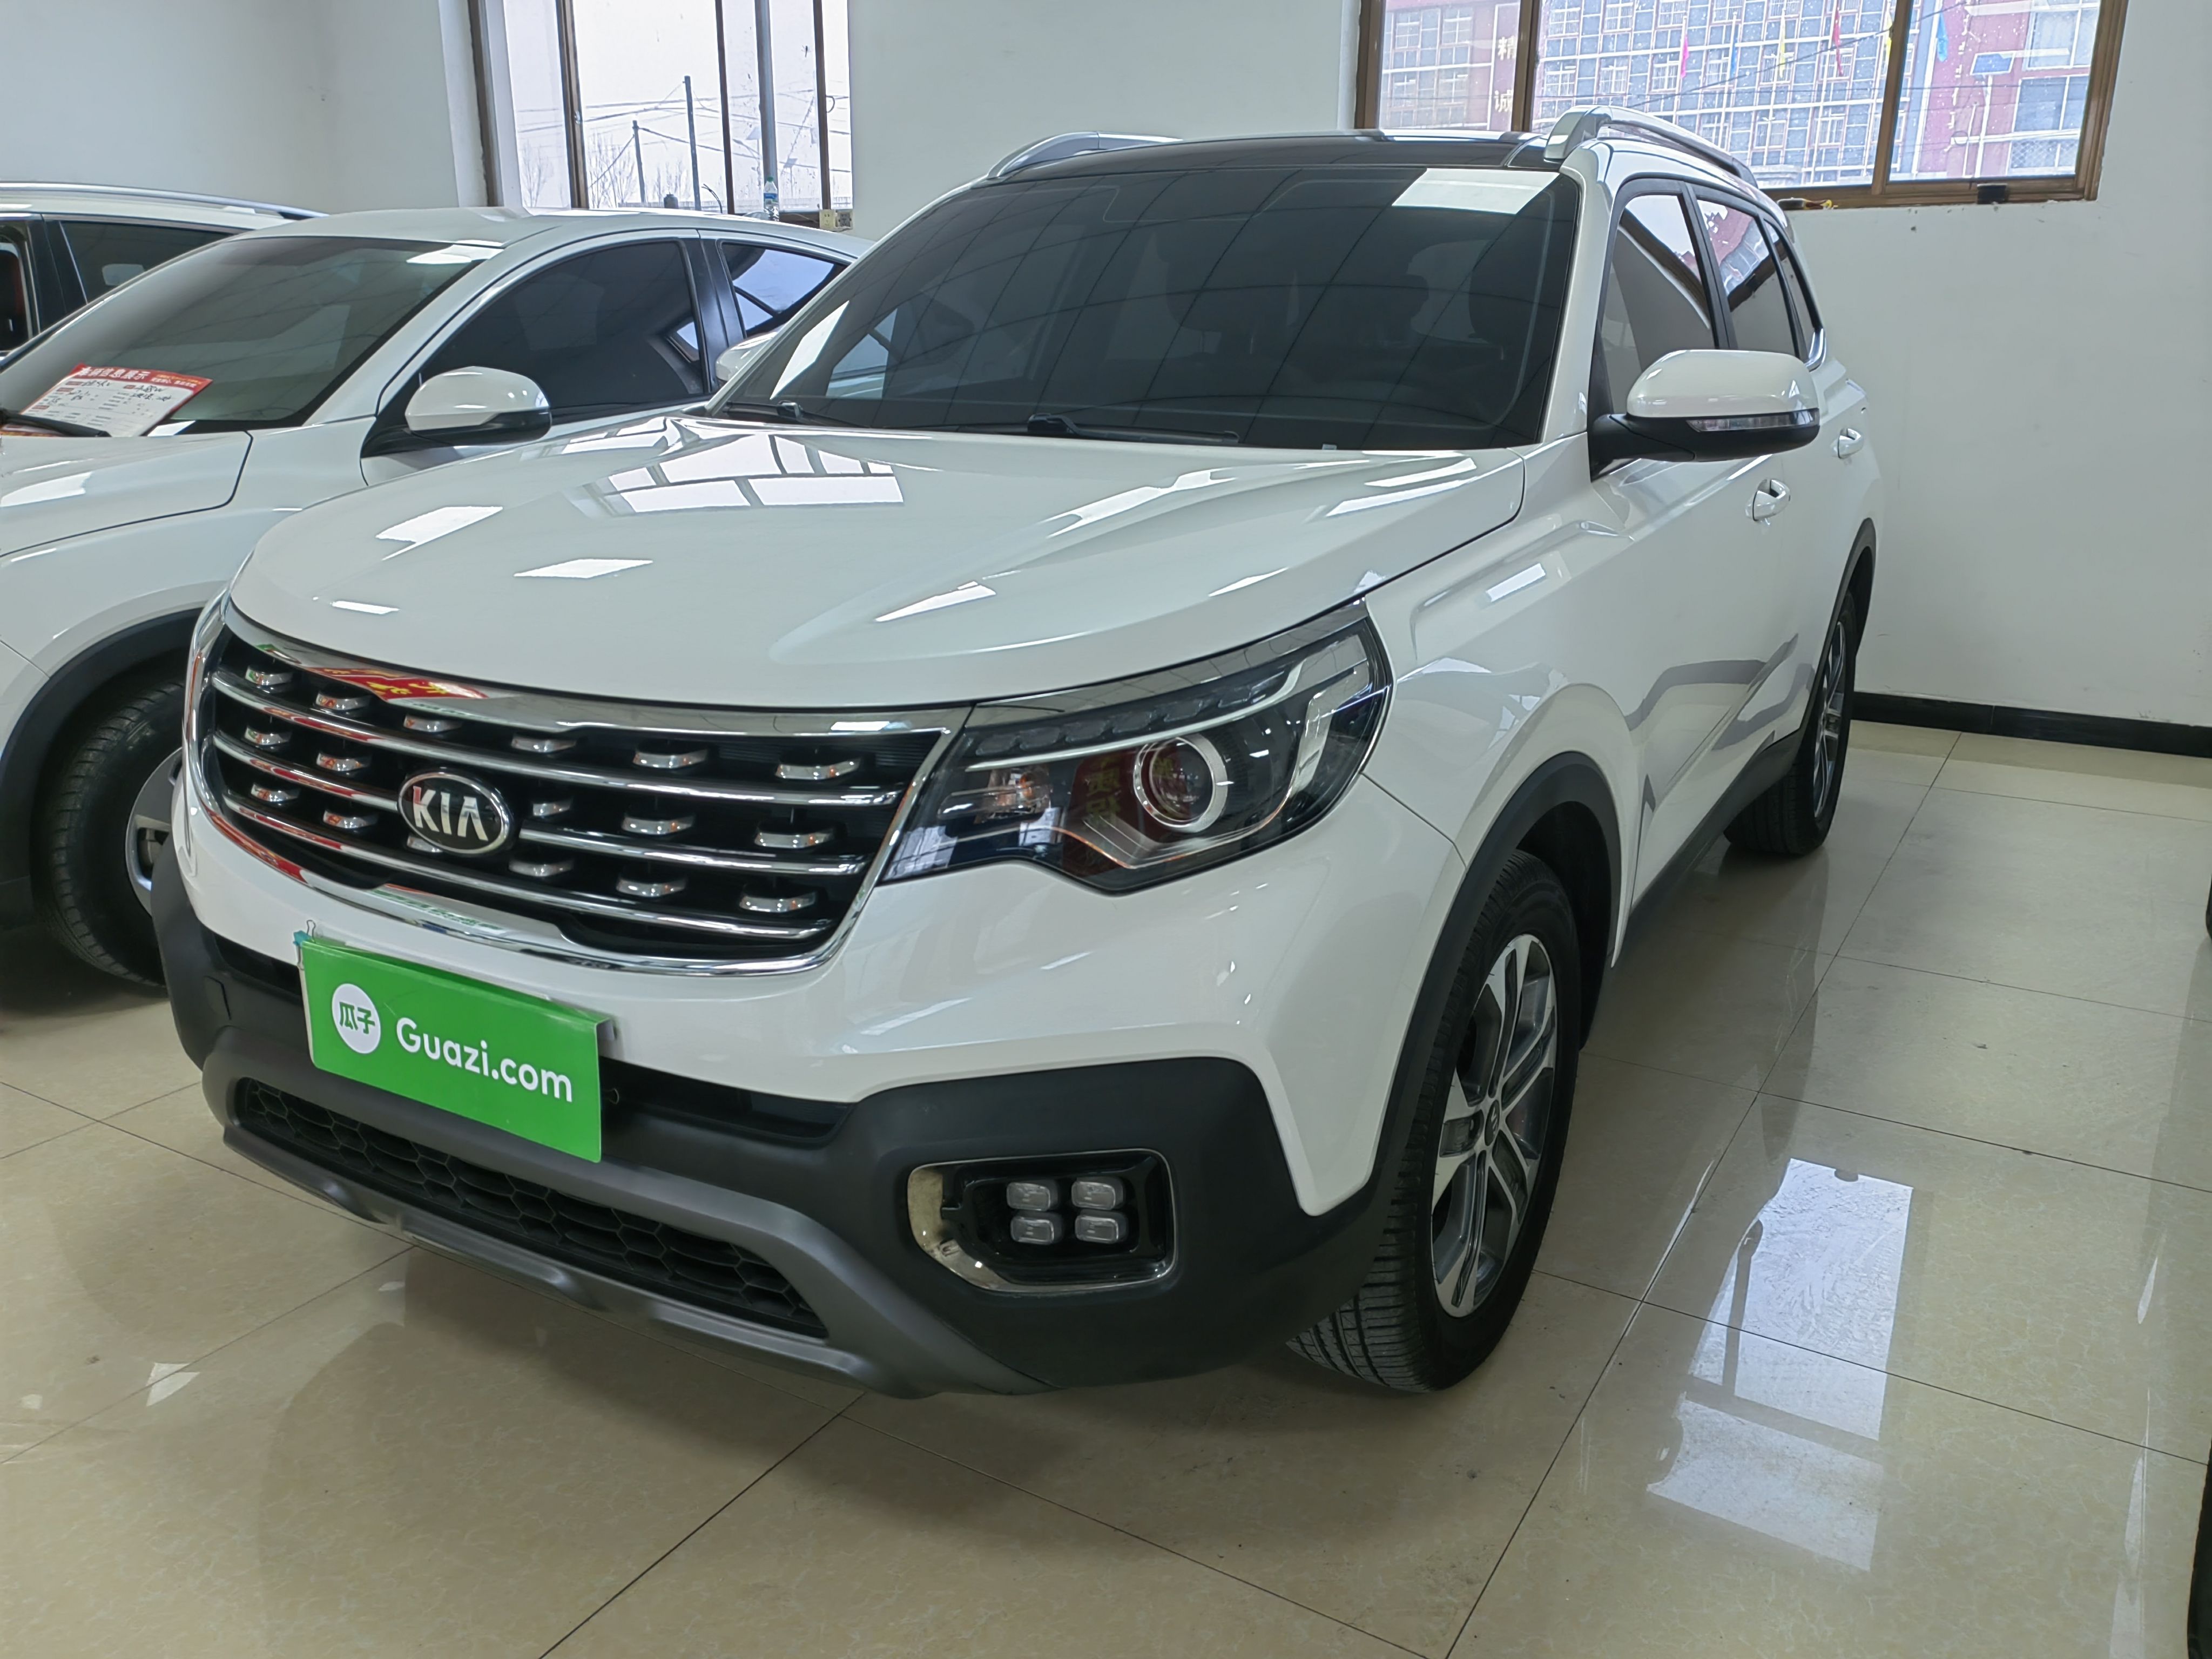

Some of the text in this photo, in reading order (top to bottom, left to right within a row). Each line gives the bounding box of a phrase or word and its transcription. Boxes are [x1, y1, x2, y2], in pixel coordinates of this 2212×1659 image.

[413, 786, 488, 841] KIA
[339, 1001, 375, 1035] 瓜子
[396, 1017, 572, 1102] Guazi.com
